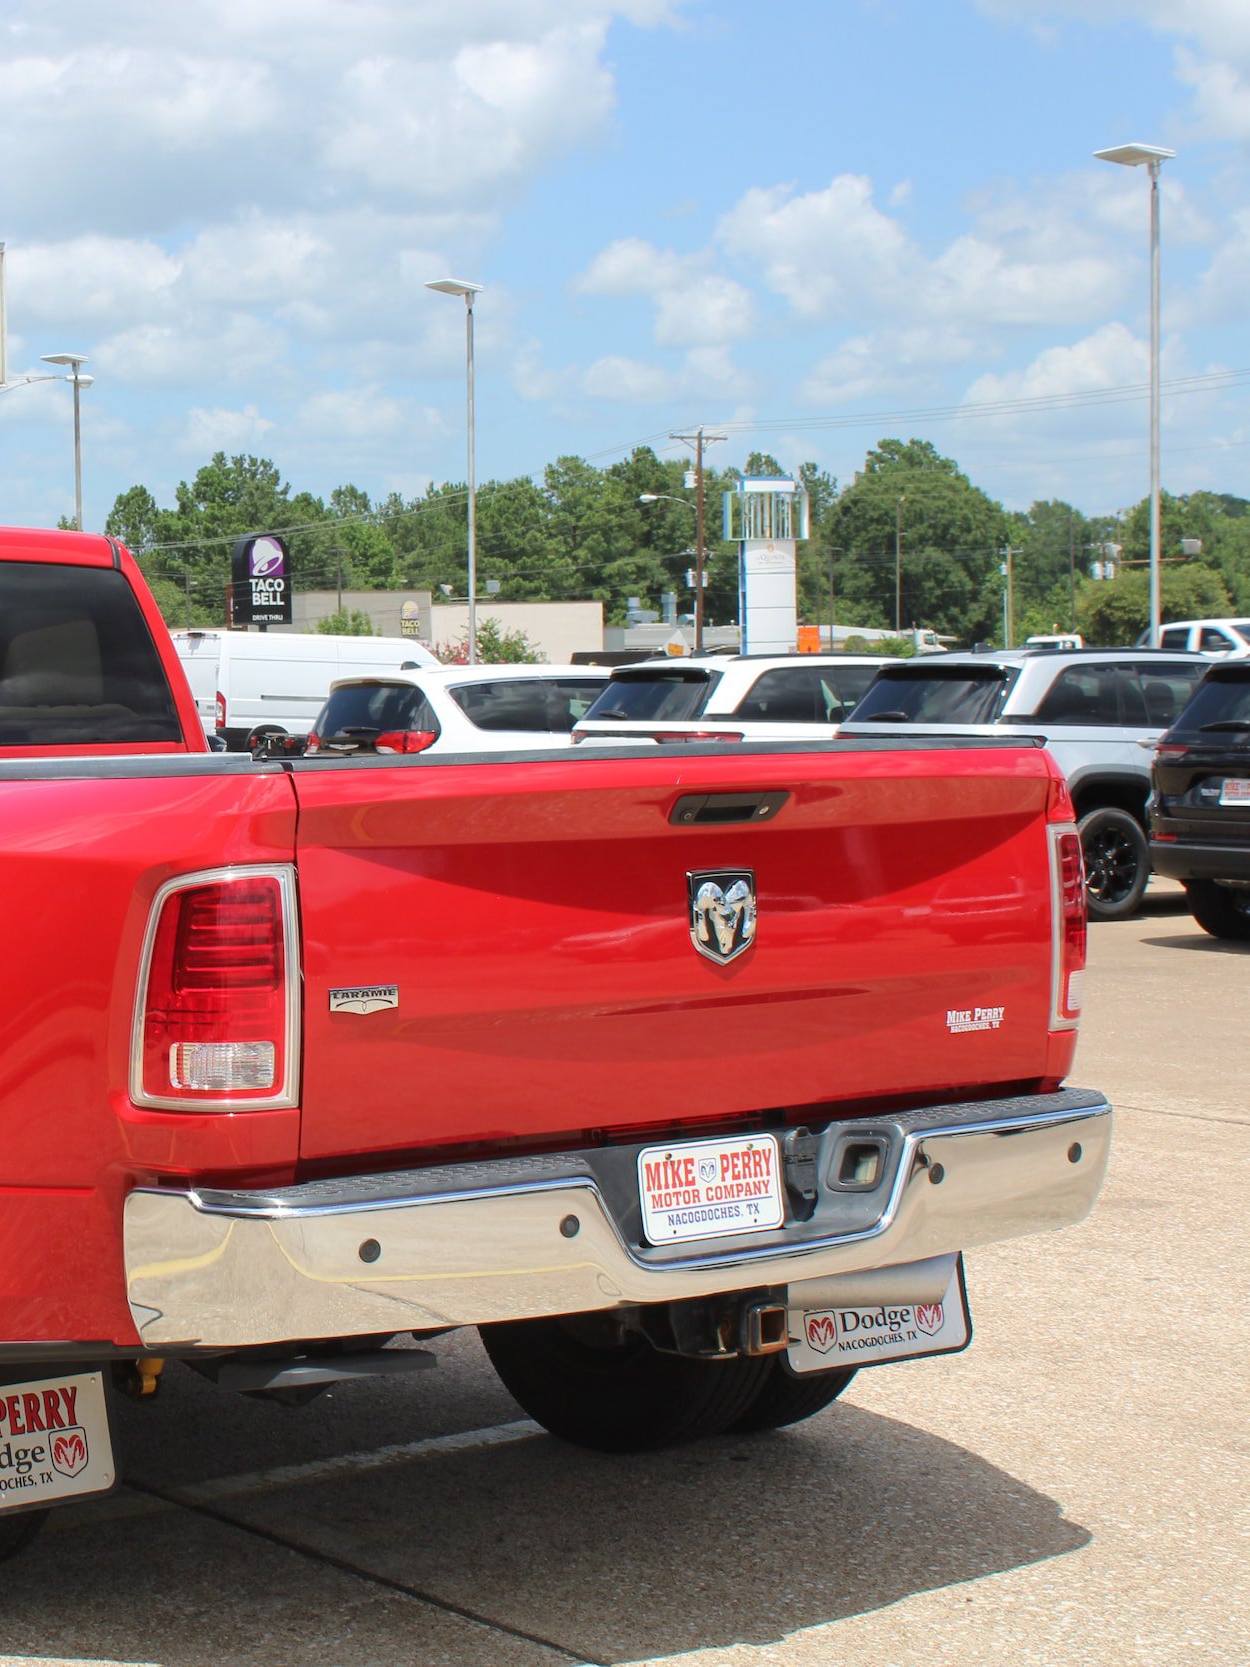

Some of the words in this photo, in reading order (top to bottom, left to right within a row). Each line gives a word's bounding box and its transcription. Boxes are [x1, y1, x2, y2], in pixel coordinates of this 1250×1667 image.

[249, 579, 284, 592] TACO
[252, 592, 285, 606] BELL
[401, 620, 420, 628] TACO
[402, 628, 419, 636] BELL
[332, 988, 396, 1000] LARAMIE
[644, 1157, 696, 1192] MIKE
[719, 1148, 772, 1182] PERRY
[651, 1189, 701, 1209] MOTOR
[705, 1180, 771, 1202] COMPANY
[667, 1205, 744, 1226] NACOGDOCHES,
[746, 1203, 760, 1215] TX
[838, 1307, 911, 1332] Dodge
[838, 1333, 906, 1352] NACOGDOCHES,
[906, 1330, 918, 1341] TX
[39, 1471, 54, 1484] TX
